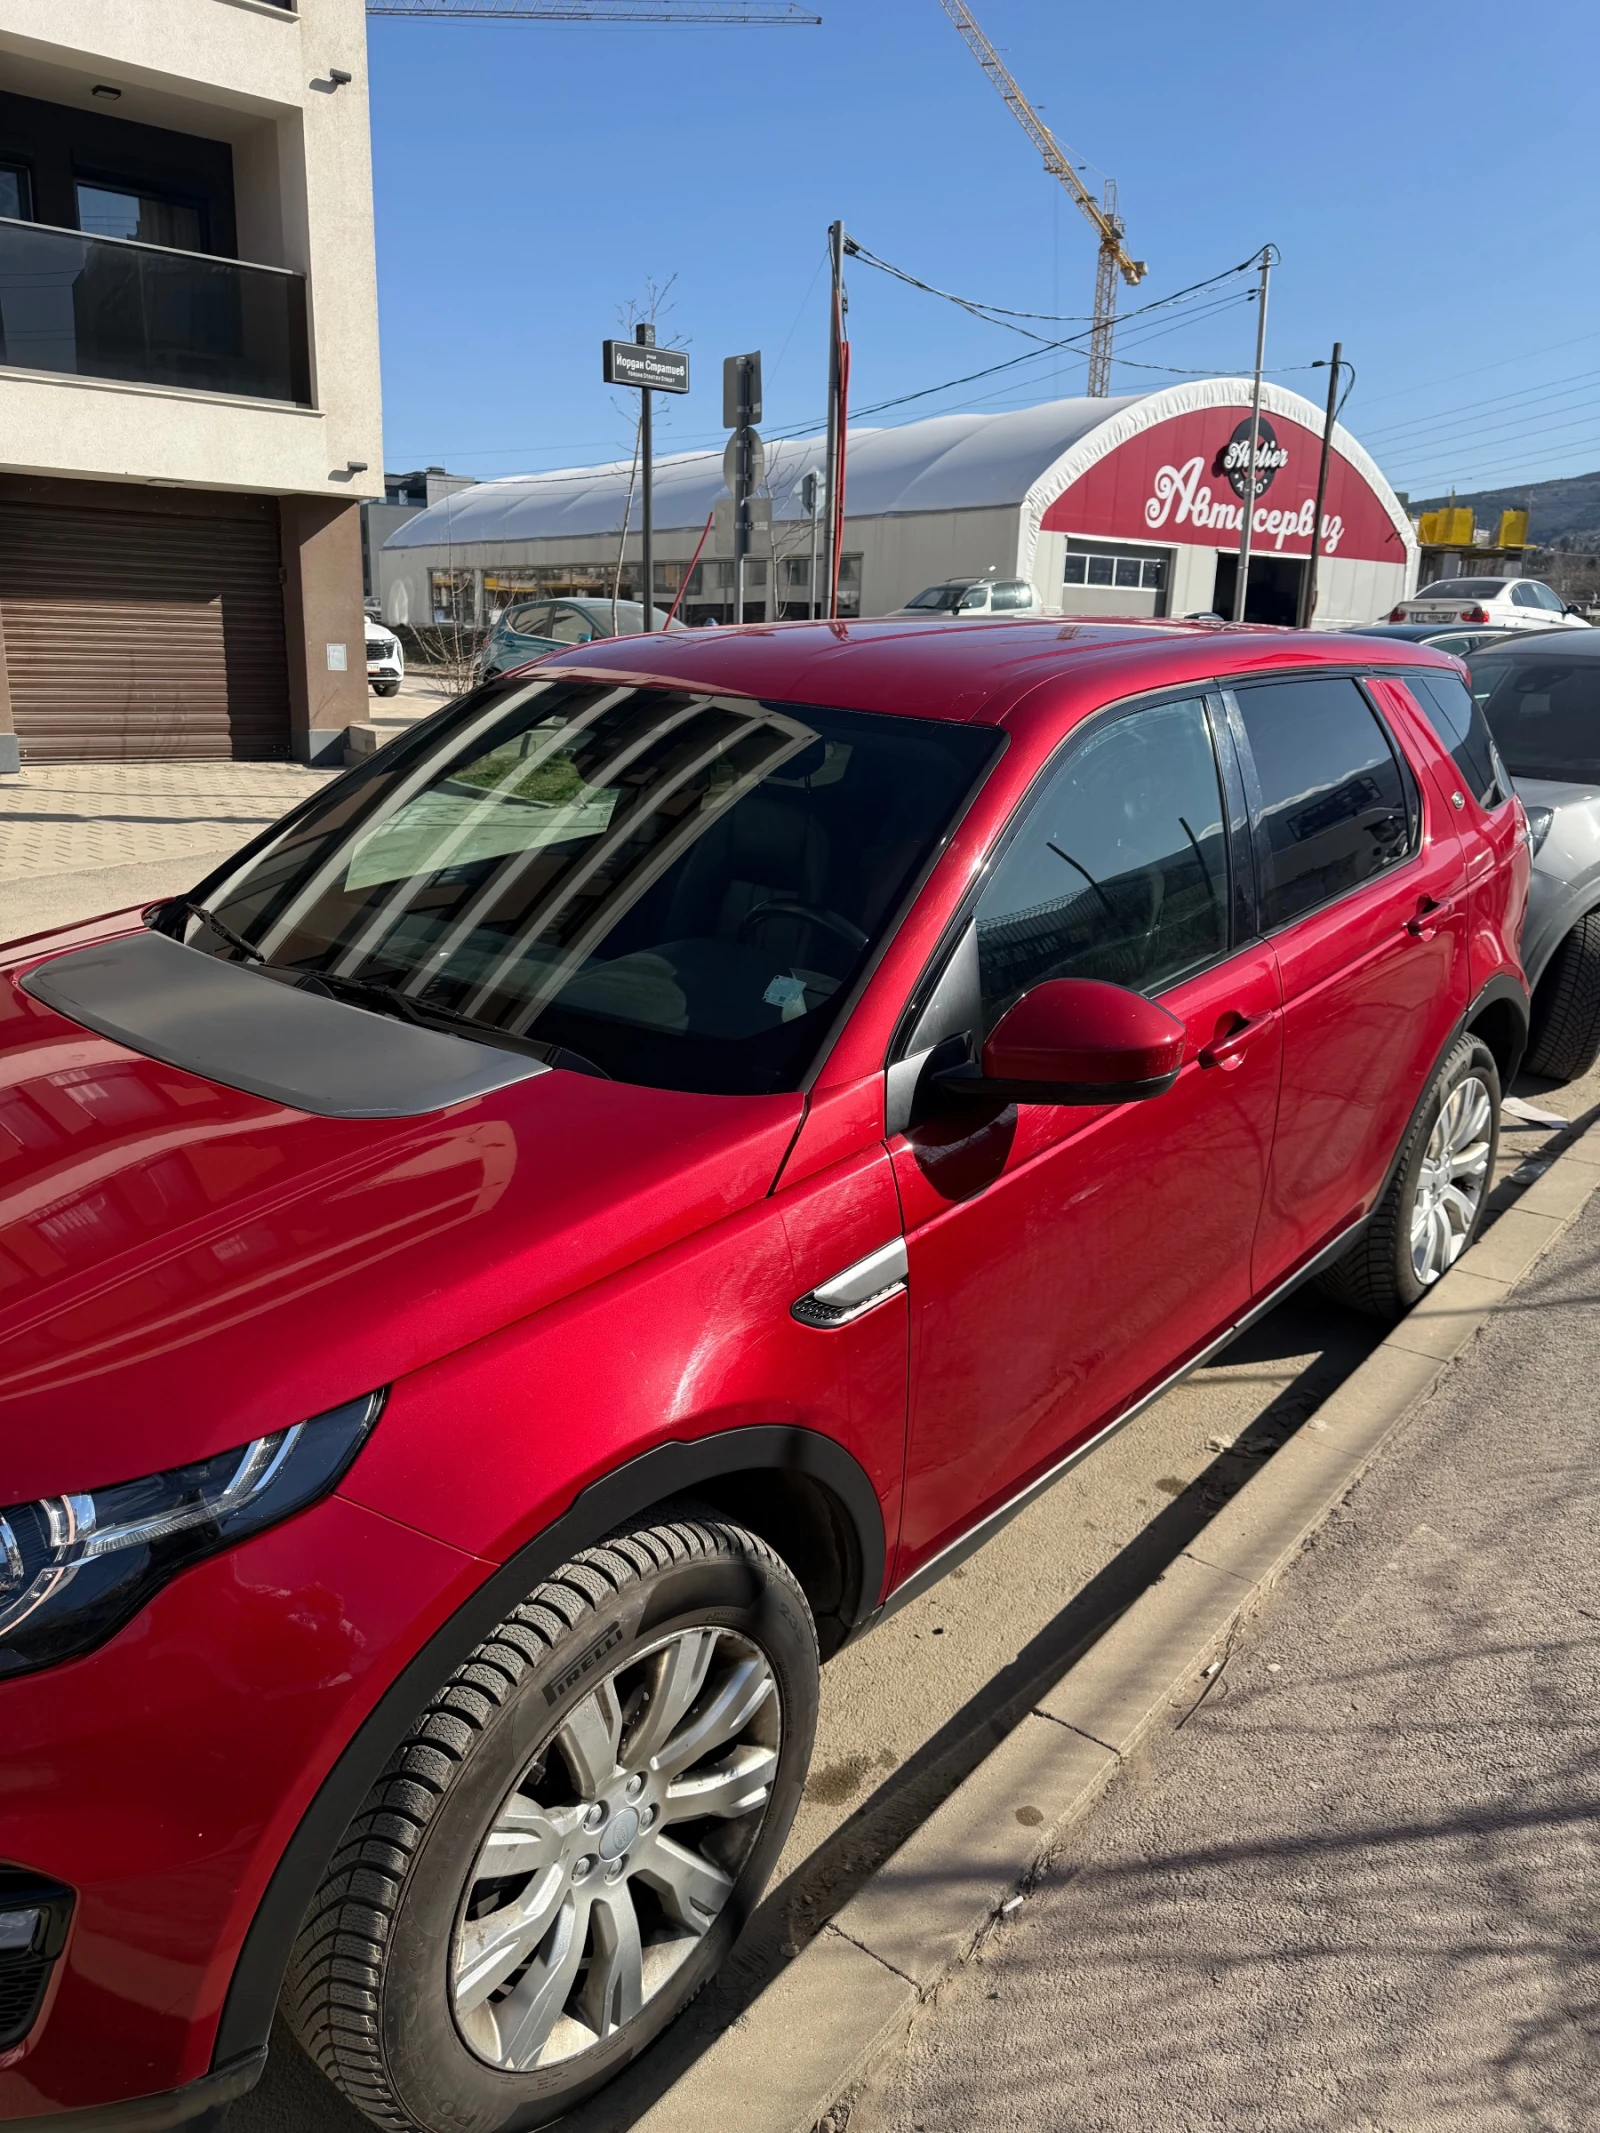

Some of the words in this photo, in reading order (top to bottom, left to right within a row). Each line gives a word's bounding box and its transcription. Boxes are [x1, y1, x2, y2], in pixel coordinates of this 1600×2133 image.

[616, 353, 644, 370] Йордан
[1236, 480, 1264, 493] AO
[541, 1620, 624, 1707] PIRELLI
